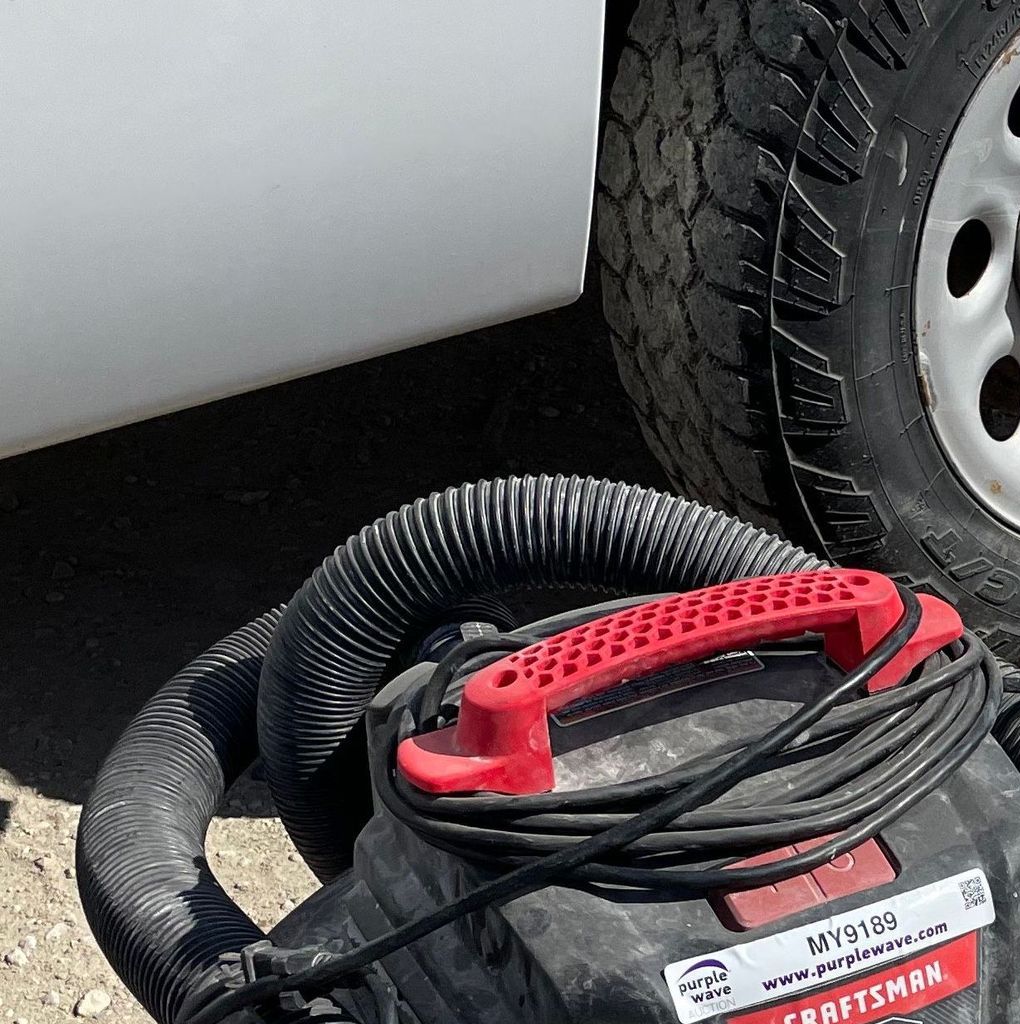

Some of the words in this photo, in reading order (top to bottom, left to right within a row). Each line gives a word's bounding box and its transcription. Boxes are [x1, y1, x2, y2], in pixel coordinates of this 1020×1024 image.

[806, 911, 898, 956] MY9189
[762, 921, 948, 991] www.purplewave.com
[679, 970, 728, 996] purple
[690, 985, 732, 1004] wave
[688, 997, 736, 1018] AUCTION
